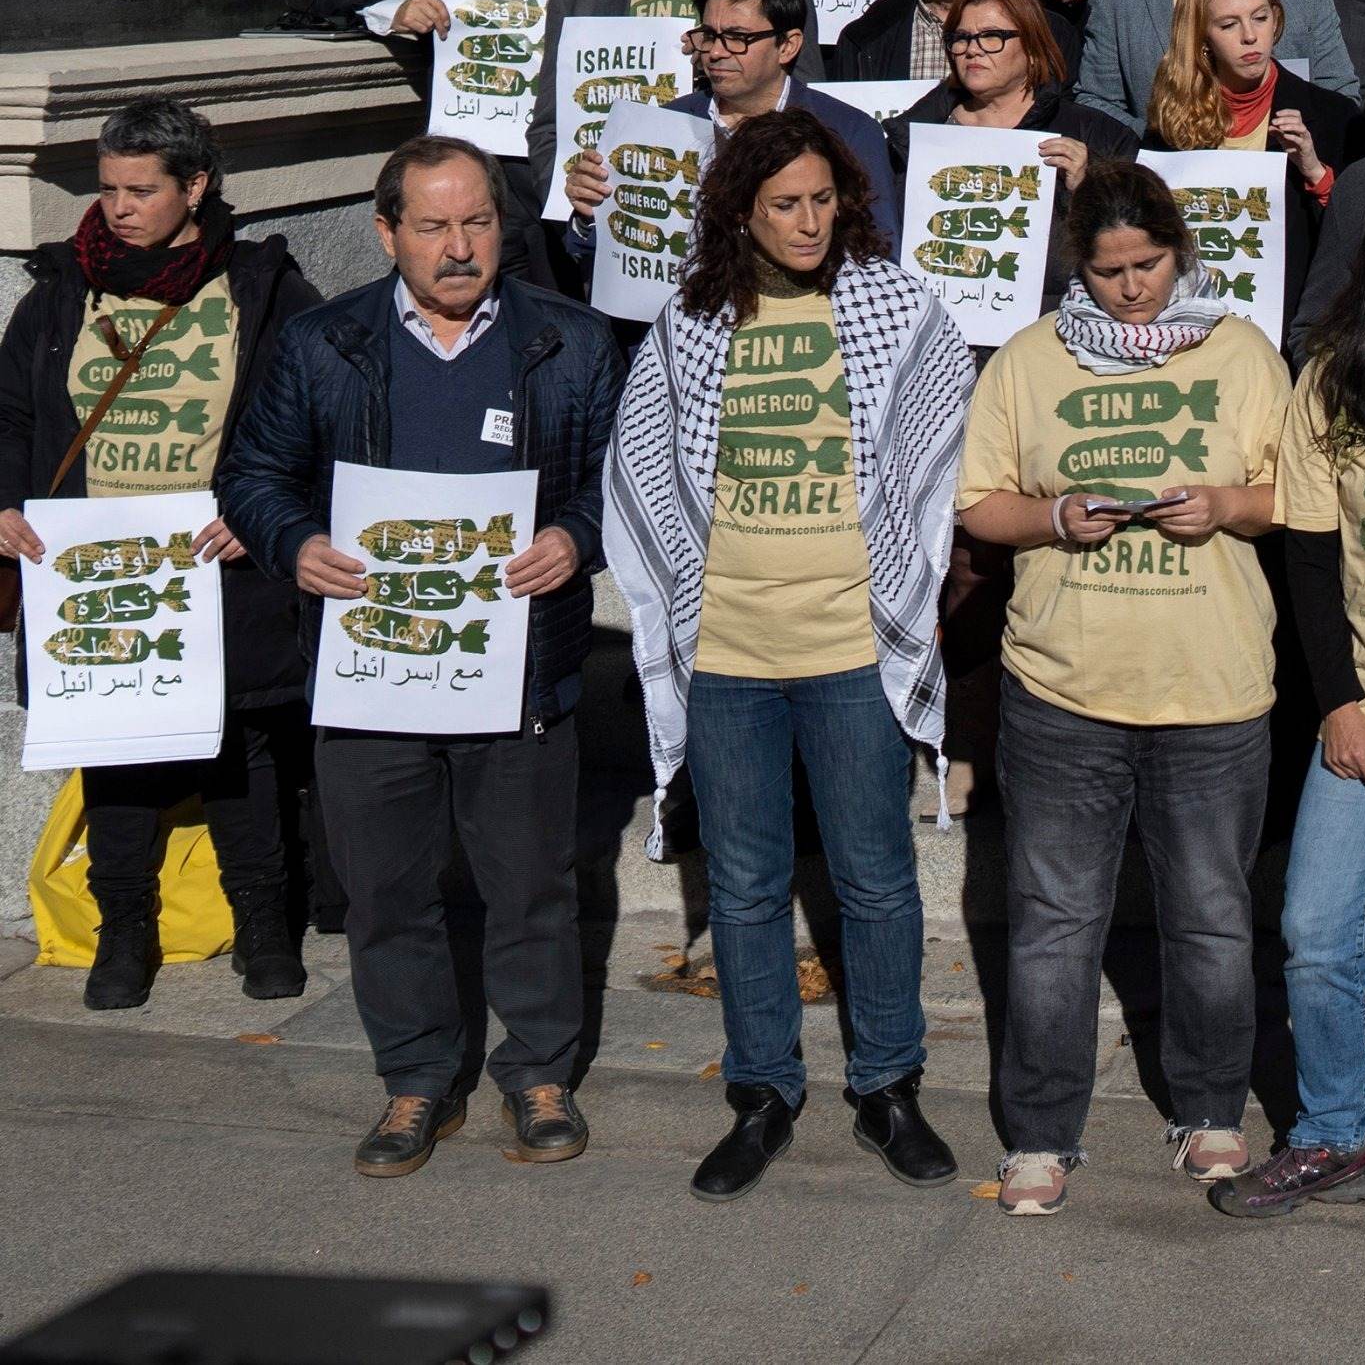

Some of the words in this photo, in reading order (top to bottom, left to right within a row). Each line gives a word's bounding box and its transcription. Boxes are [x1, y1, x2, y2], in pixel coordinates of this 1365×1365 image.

[577, 41, 656, 73] ISRAELÍ
[588, 82, 640, 103] ARMAK
[623, 153, 649, 175] FIN
[619, 191, 667, 211] COMERCIO
[625, 228, 659, 246] ARMAS
[734, 335, 784, 368] FIN
[793, 336, 814, 353] AL
[1082, 392, 1135, 421] FIN
[1142, 393, 1161, 411] AL
[93, 440, 197, 472] ISRAEL
[734, 448, 795, 466] ARMAS
[1067, 446, 1165, 471] COMERCIO
[730, 482, 841, 516] ISRAEL
[1082, 543, 1190, 575] ISRAEL
[152, 673, 182, 697] مع
[451, 669, 483, 692] مع
